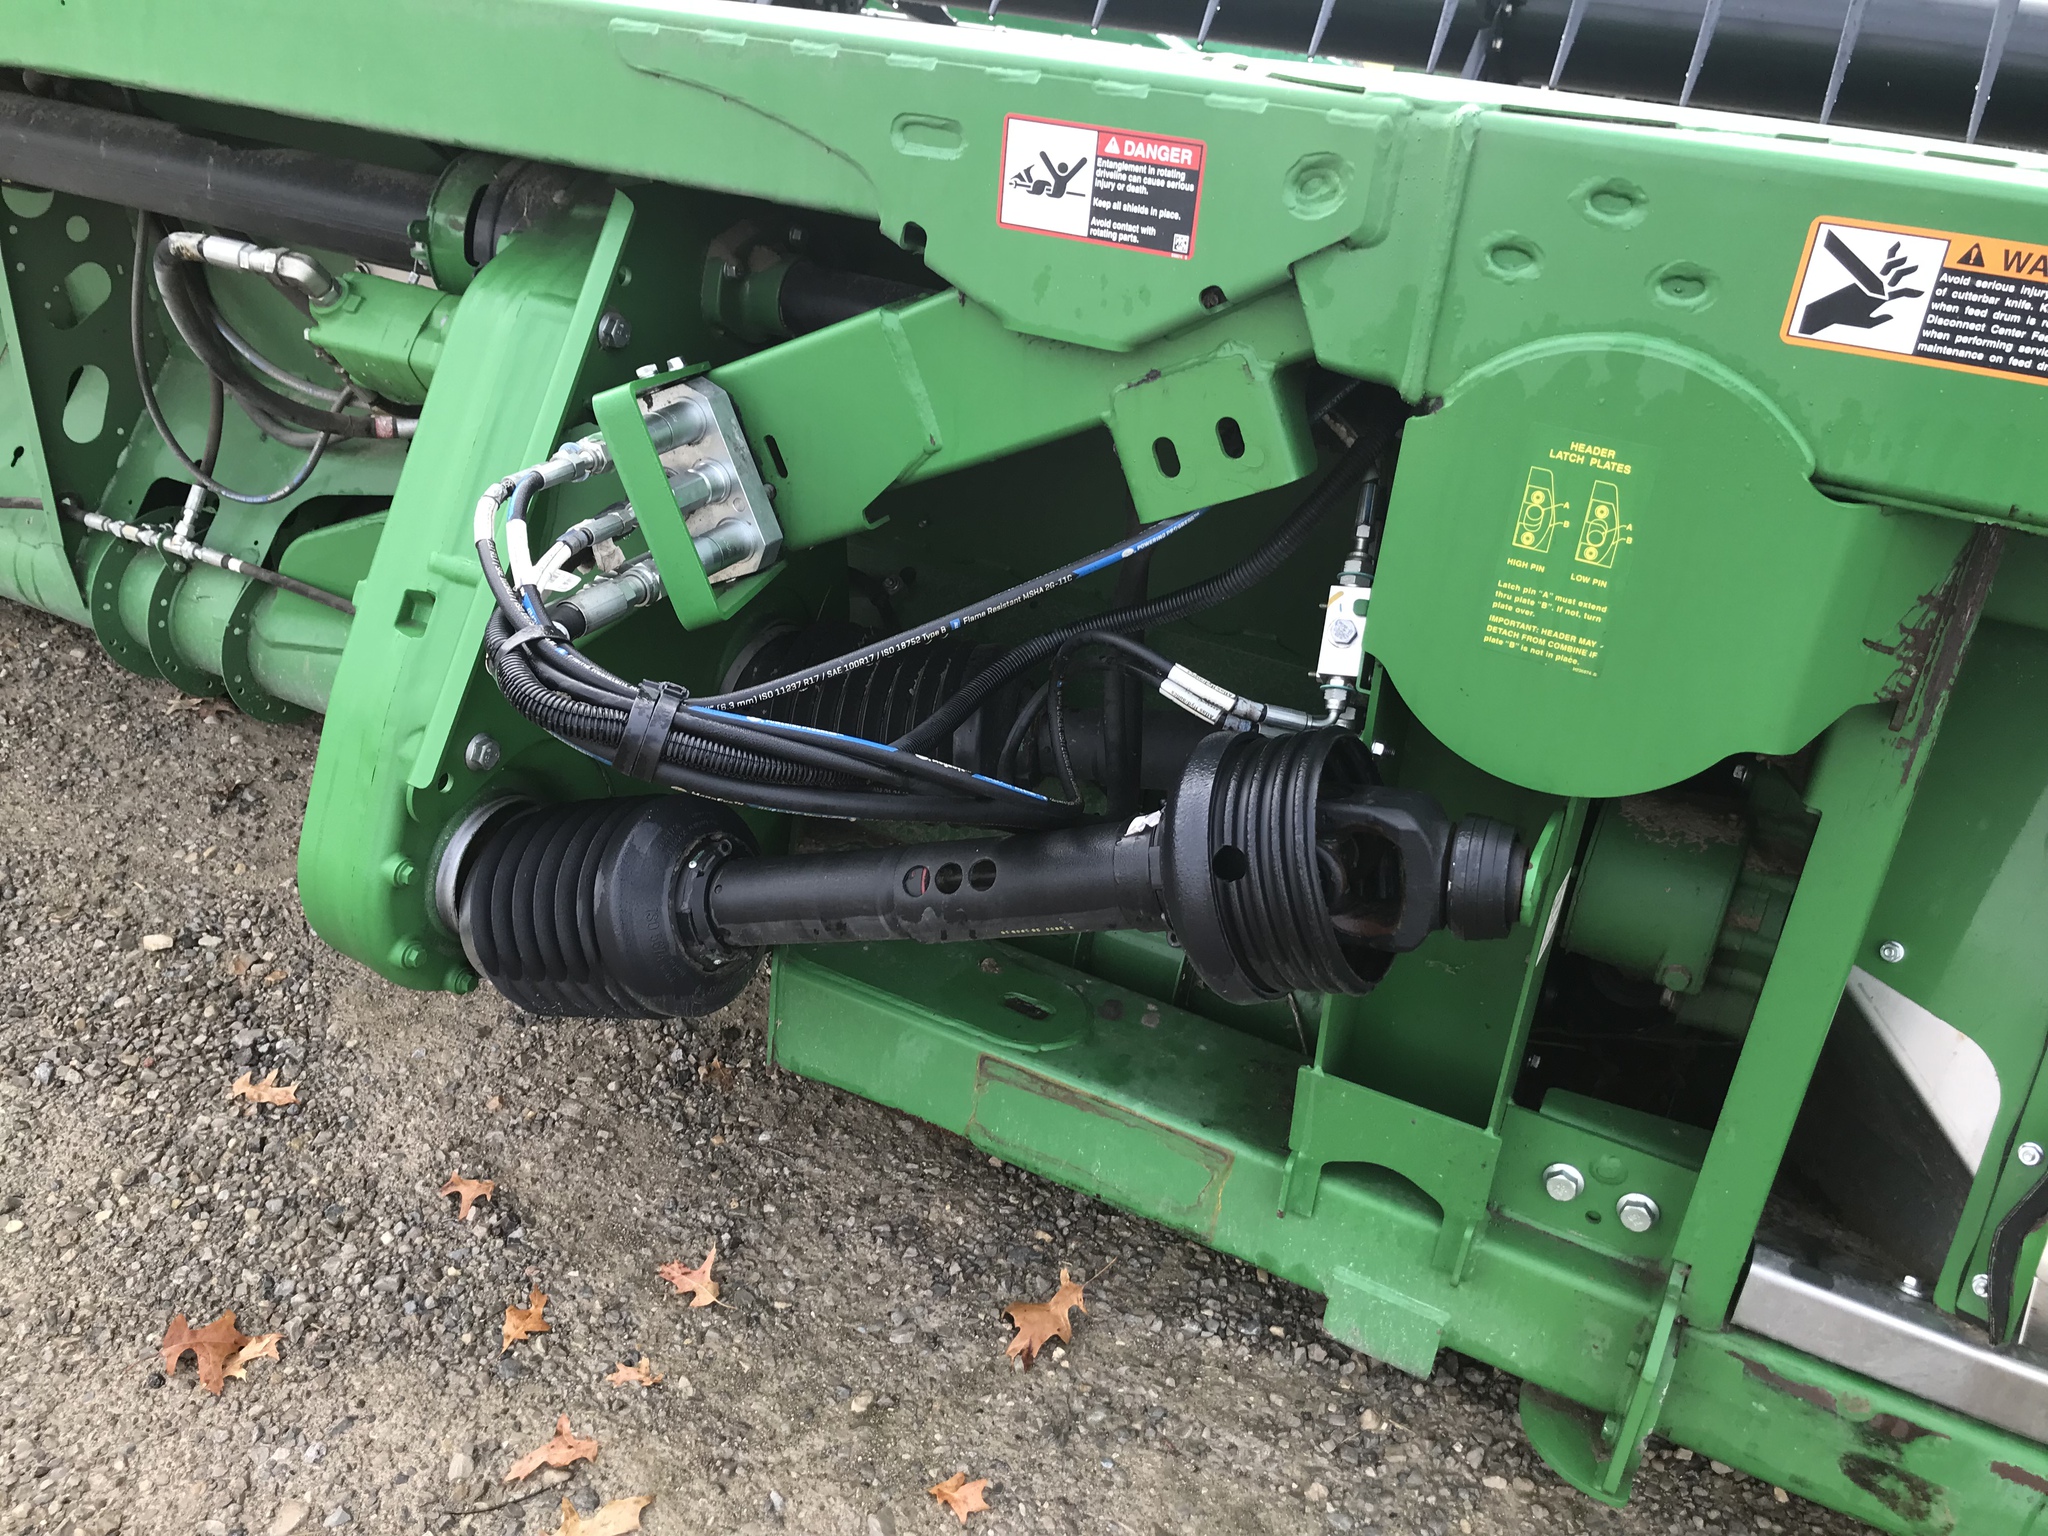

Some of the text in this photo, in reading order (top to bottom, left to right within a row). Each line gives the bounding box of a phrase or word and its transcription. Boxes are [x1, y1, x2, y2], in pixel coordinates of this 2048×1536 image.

[1124, 139, 1193, 165] DANGER
[1095, 168, 1195, 192] driveline can cause serious
[1096, 157, 1186, 182] Entanglement in rotating
[1094, 178, 1149, 195] injury or death.
[1092, 197, 1181, 221] Keep all shields in place.
[1089, 227, 1139, 244] rotating parts.
[1090, 216, 1157, 237] Avoid contact with
[1939, 272, 1971, 287] Avoid
[1975, 277, 2016, 293] serious
[1935, 287, 1948, 298] of
[1951, 290, 2001, 305] cutterbar
[2004, 297, 2034, 311] knife.
[1931, 301, 1960, 314] when
[1964, 305, 1989, 318] feed
[1992, 310, 2021, 324] drum
[2026, 315, 2037, 326] is
[1926, 313, 1986, 333] Disconnect
[1990, 324, 2027, 339] Center
[1922, 328, 1951, 341] when
[1954, 333, 2014, 354] performing
[1917, 342, 1985, 361] maintenance
[1989, 353, 2004, 364] on
[2008, 356, 2033, 369] feed
[1549, 448, 1632, 475] LATCH PLATES
[1570, 441, 1616, 459] HEADER
[1563, 501, 1570, 509] A
[1562, 520, 1570, 528] B
[1626, 523, 1633, 531] A
[1136, 533, 1166, 551] POWERING
[1626, 537, 1633, 545] B
[1506, 557, 1545, 573] HIGH PIN
[1570, 572, 1608, 589] LOW PIN
[1495, 590, 1512, 601] thru
[1514, 595, 1536, 606] plate
[1556, 605, 1564, 613] If
[1565, 609, 1582, 619] not,
[1583, 612, 1602, 623] turn
[1497, 579, 1521, 592] Latch
[1522, 586, 1537, 596] pin
[1555, 594, 1577, 606] must
[1578, 601, 1608, 613] extend
[1492, 601, 1536, 617] plate over.
[758, 689, 775, 701] ISO
[775, 680, 802, 698] 11237
[803, 674, 820, 687] R17
[827, 666, 843, 679] SAE
[844, 653, 875, 672] 100R17
[881, 646, 896, 658] ISO
[896, 637, 921, 652] 18752
[922, 629, 940, 642] Type
[941, 625, 947, 635] B
[962, 610, 987, 625] Flame
[987, 596, 1022, 614] Resistant
[1022, 587, 1044, 601] MSHA
[1044, 573, 1073, 592] 2G-11C
[1486, 624, 1598, 659] DETACH FROM COMBINE IF
[1488, 614, 1598, 648] IMPORTANT: HEADER MAY
[1483, 635, 1504, 646] plate
[1520, 644, 1528, 652] is
[1529, 646, 1544, 656] not
[1545, 650, 1554, 659] in
[1555, 653, 1580, 666] place.
[1200, 709, 1214, 720] Atlas
